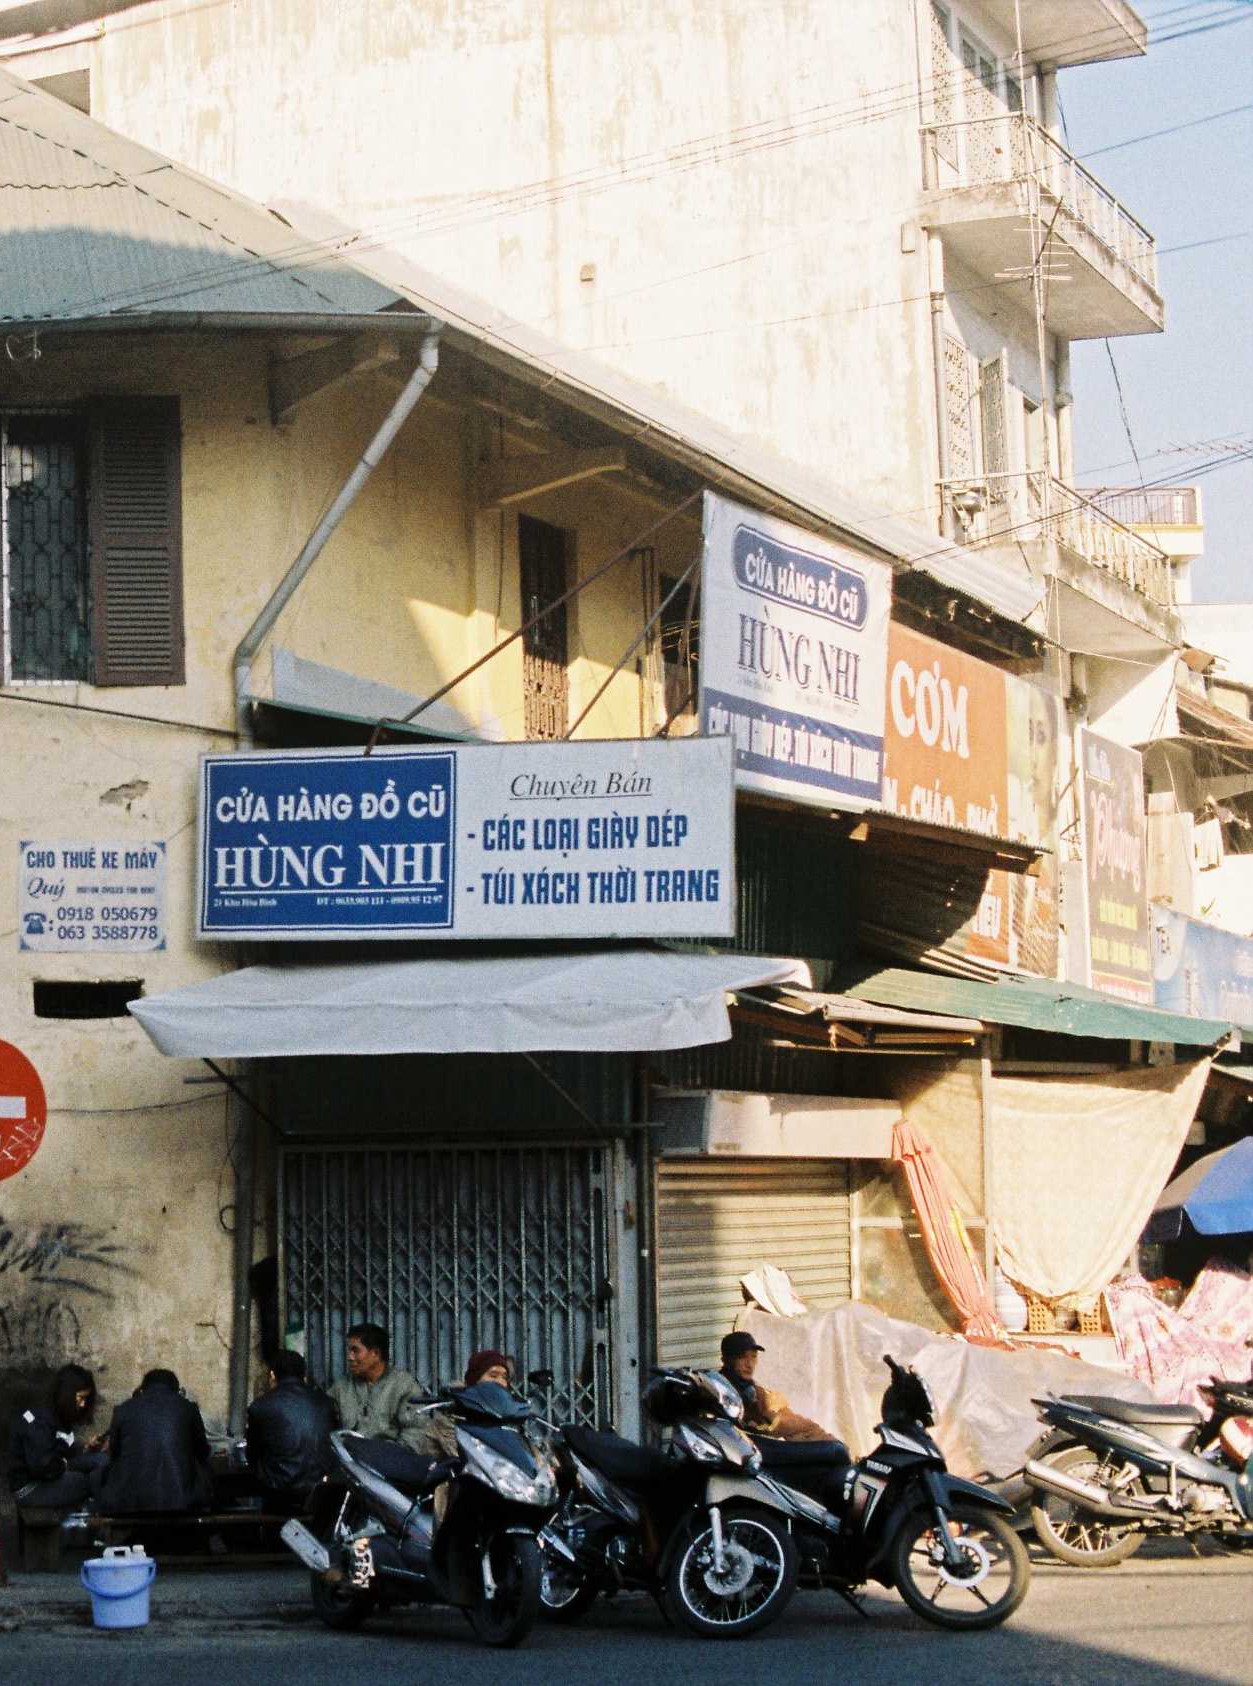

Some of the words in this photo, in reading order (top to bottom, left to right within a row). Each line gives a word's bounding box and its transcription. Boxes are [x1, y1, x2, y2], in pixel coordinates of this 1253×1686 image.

[745, 547, 775, 591] CỬA
[777, 561, 817, 600] HÀNG
[818, 570, 839, 613] ĐỒ
[840, 586, 859, 621] CŨ
[738, 605, 813, 689] HÙNG
[817, 641, 861, 702] NHI
[891, 659, 970, 758] CƠM
[216, 780, 269, 823] CỬA
[278, 786, 353, 822] HÀNG
[360, 778, 401, 820] ĐỒ
[407, 782, 445, 820] CŨ
[510, 772, 597, 801] Chuyên
[606, 771, 652, 797] Bán
[483, 811, 526, 852] CÁC
[533, 818, 579, 857] LOẠI
[587, 811, 639, 850] GIÀY
[646, 809, 687, 848] DÉP
[27, 851, 55, 868] CHO
[62, 847, 95, 868] THUÊ
[102, 851, 118, 869] XE
[125, 847, 157, 869] MÁY
[214, 834, 346, 889] HÙNG
[358, 842, 445, 887] NHI
[27, 877, 64, 901] Quý
[481, 868, 515, 905] TÚI
[521, 869, 579, 905] XÁCH
[587, 866, 637, 903] THỜI
[644, 869, 720, 903] TRANG
[57, 907, 94, 921] 0918
[101, 907, 158, 921] 050679
[57, 926, 85, 940] 063
[92, 926, 158, 940] 3588778
